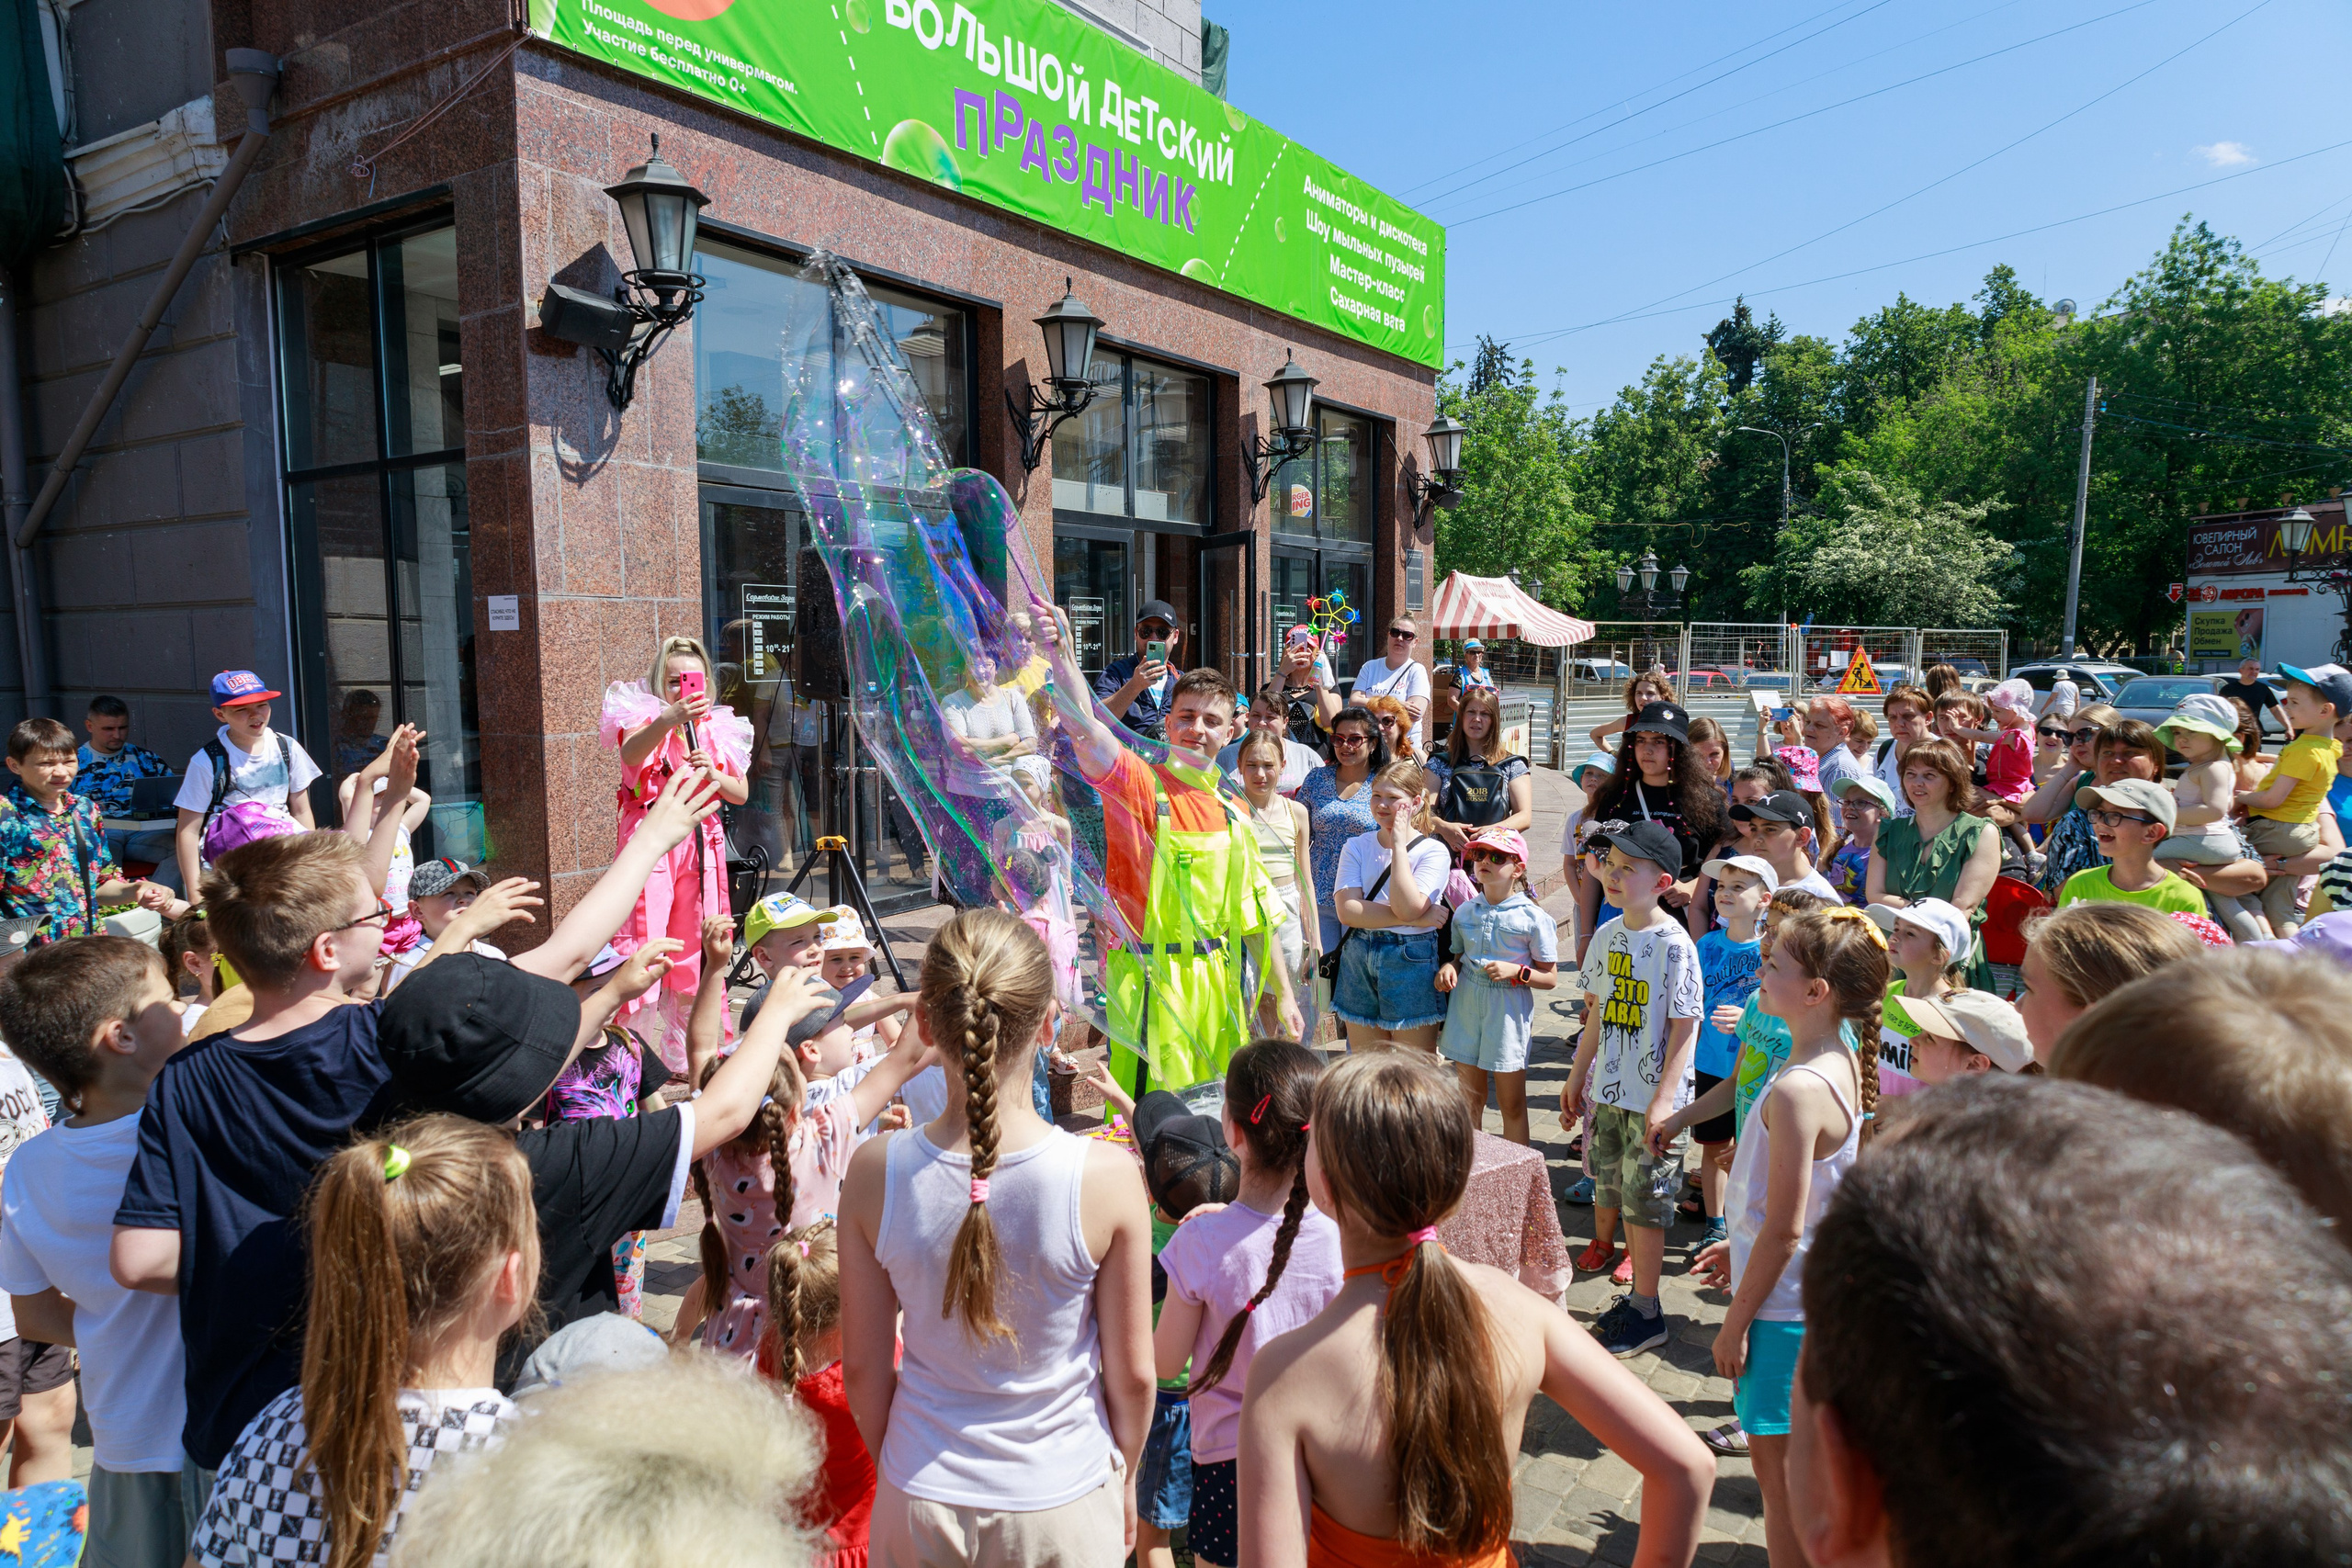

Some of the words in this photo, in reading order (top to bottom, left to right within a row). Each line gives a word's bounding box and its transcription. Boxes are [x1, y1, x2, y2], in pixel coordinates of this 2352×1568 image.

[582, 0, 653, 37] Площадь
[656, 28, 703, 57] перед
[704, 47, 799, 96] универмагом.
[582, 18, 648, 57] Участие
[650, 46, 727, 87] бесплатно
[1100, 78, 1235, 186] ДЕТСКИЙ
[954, 86, 1198, 235] ПРАЗДНИК
[1303, 175, 1368, 226] Аниматоры
[1371, 213, 1377, 231] и
[1378, 220, 1428, 257] дискотека
[1306, 208, 1331, 243] Шоу
[1333, 227, 1383, 265] мыльных
[1385, 253, 1425, 284] пузырей
[1329, 254, 1406, 303] Мастер-класс
[1329, 286, 1381, 324] Сахарная
[1384, 311, 1406, 333] вата
[2192, 526, 2257, 545] ЮВЕЛИРНЫЙ
[2204, 542, 2243, 556] САЛОН
[2194, 617, 2226, 626] Скупка
[2194, 626, 2233, 637] Продажа
[2193, 637, 2222, 645] Обмен
[227, 672, 260, 690] OBEY
[1466, 787, 1488, 795] 2018
[1608, 950, 1633, 977] ПОЛ
[1613, 977, 1649, 1007] ЭТО
